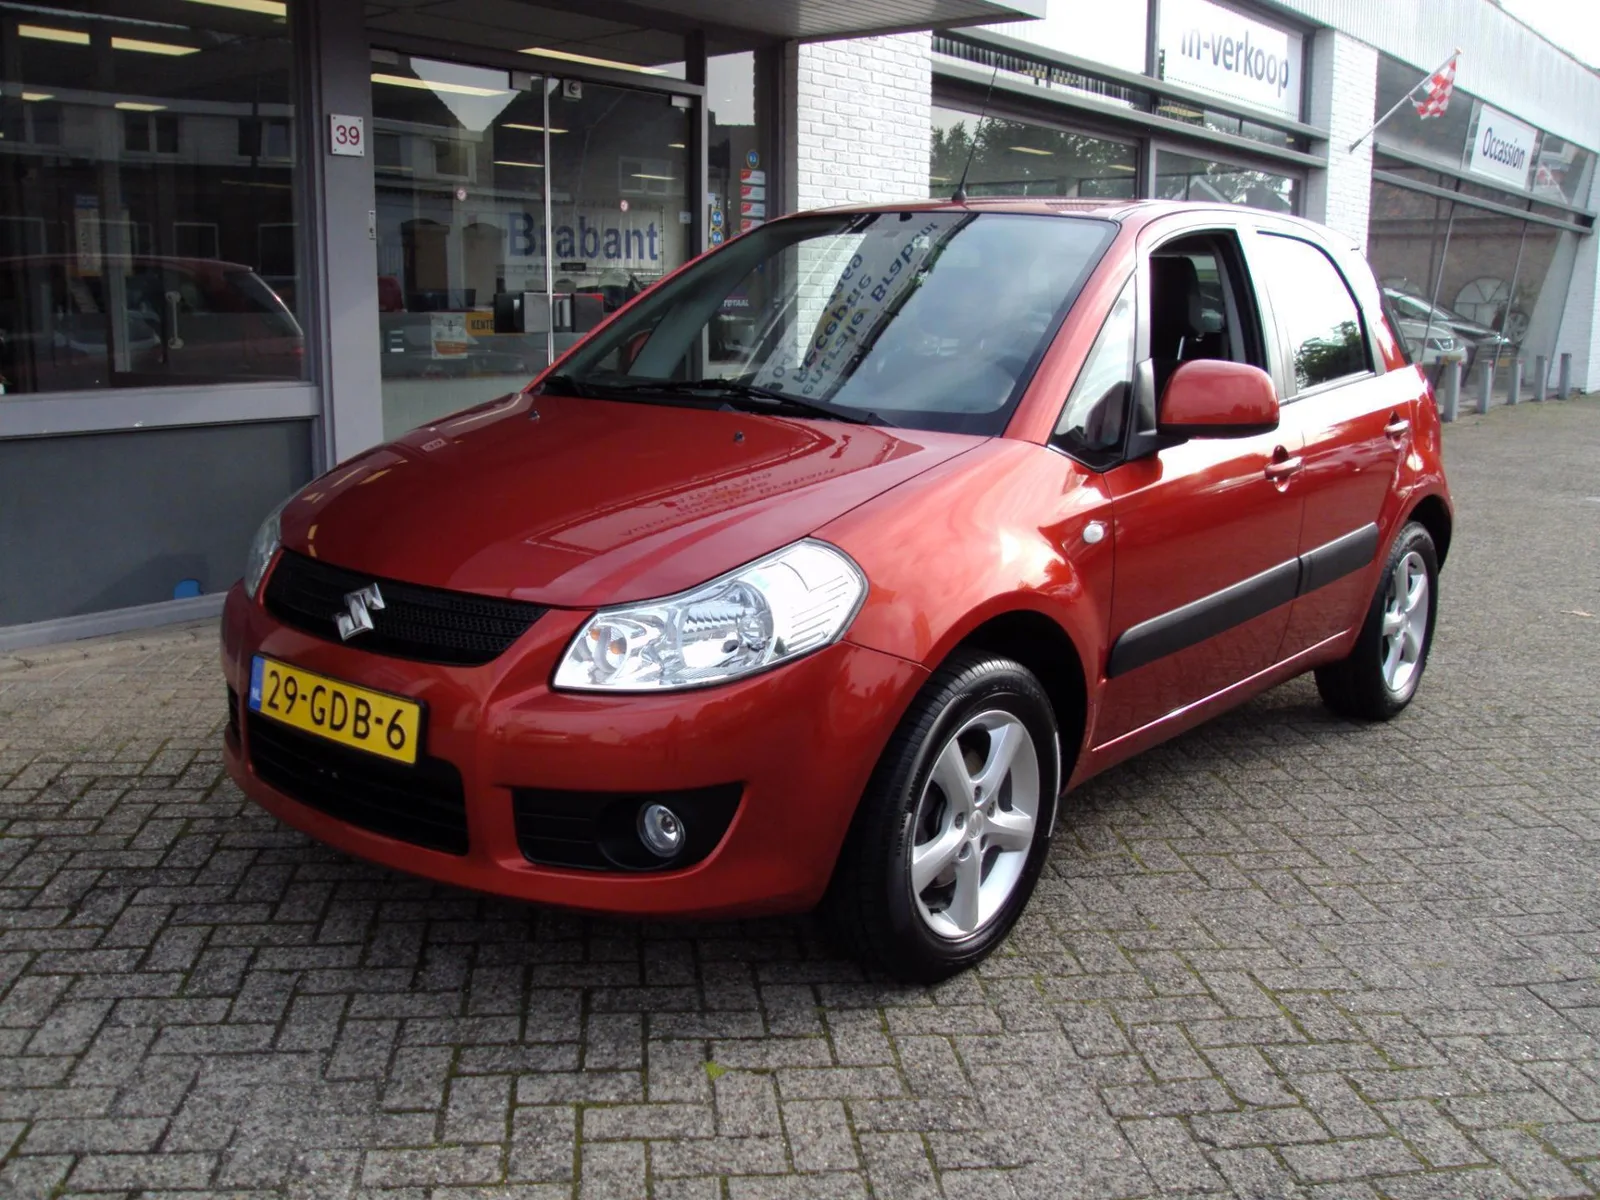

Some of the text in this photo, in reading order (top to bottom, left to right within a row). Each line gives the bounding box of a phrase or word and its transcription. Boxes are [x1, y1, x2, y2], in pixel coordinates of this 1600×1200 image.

[336, 125, 360, 146] 39
[1482, 127, 1526, 170] Occassion
[508, 211, 658, 261] Brabant
[267, 670, 406, 751] 29-GDB-6
